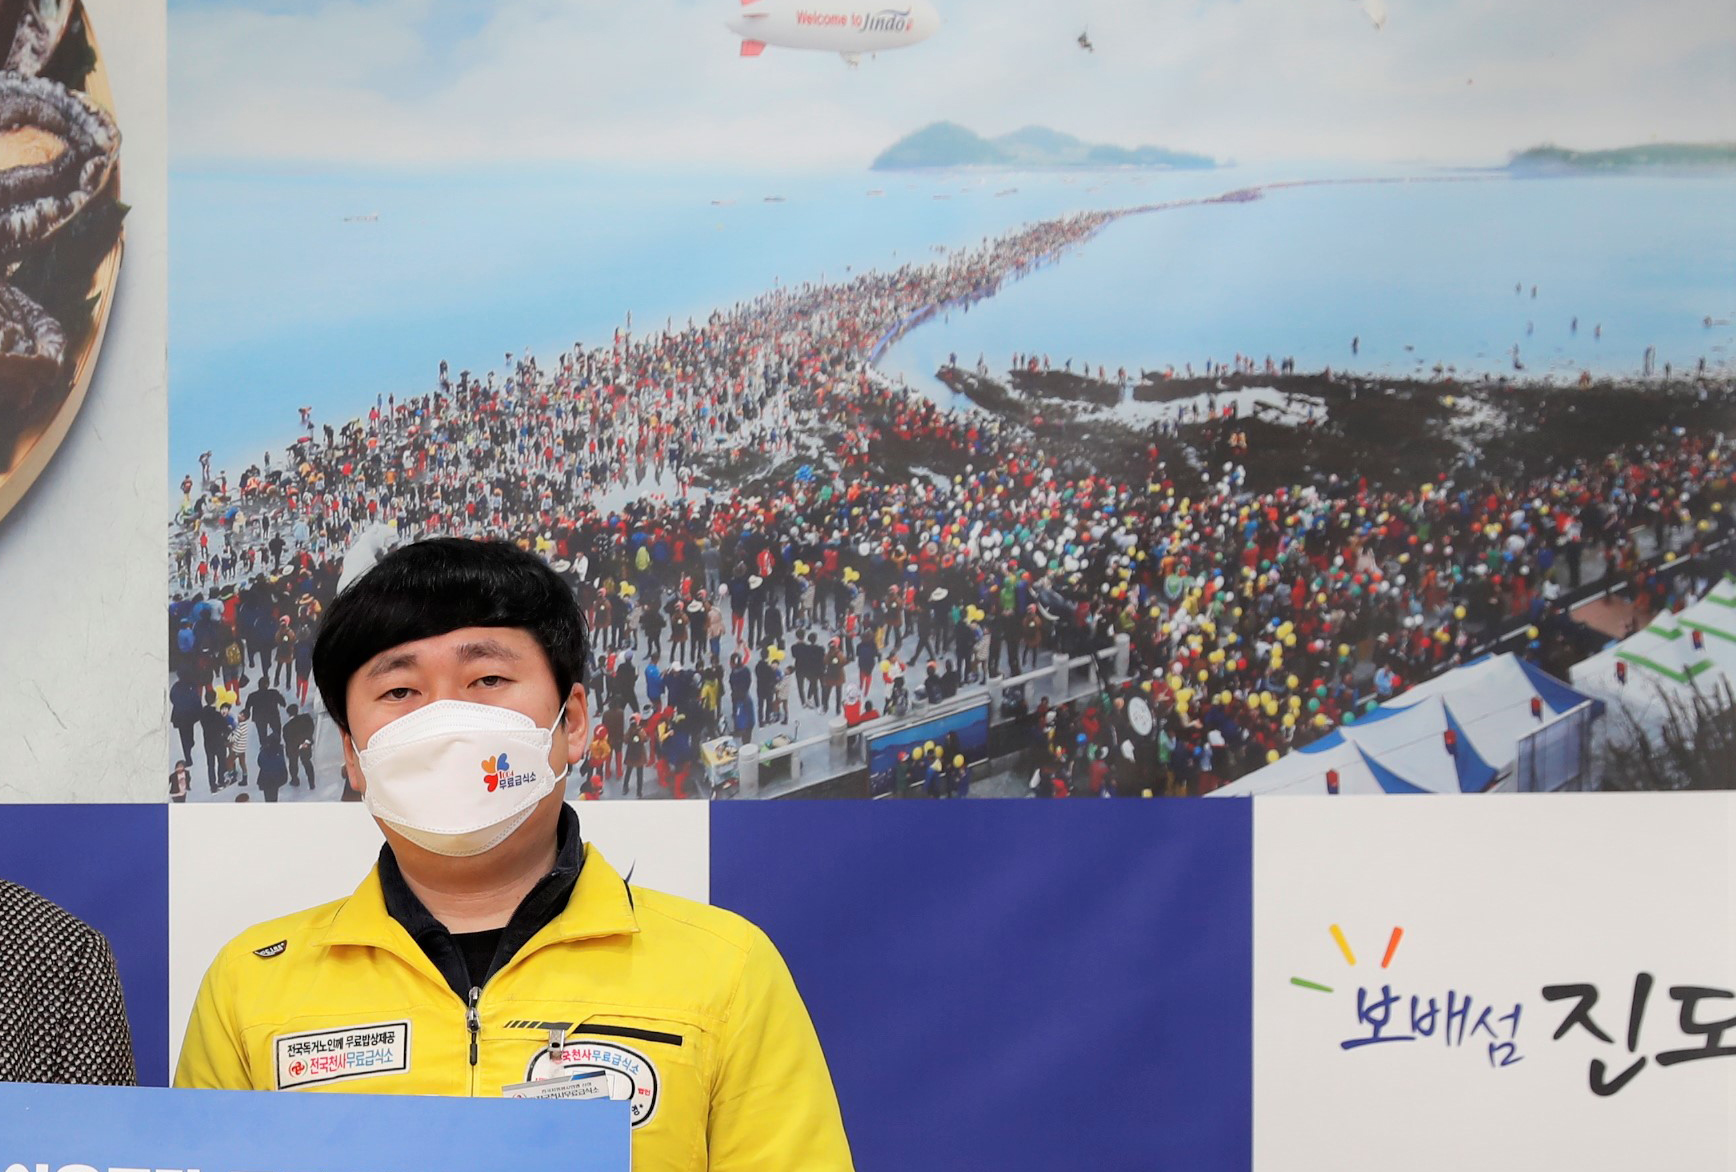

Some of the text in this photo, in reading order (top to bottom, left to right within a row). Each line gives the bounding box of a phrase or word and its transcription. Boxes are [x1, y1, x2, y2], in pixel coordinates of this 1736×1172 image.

[796, 9, 905, 33] Welcome to Jindo
[499, 771, 537, 790] 무료급식소
[345, 1031, 396, 1049] 무료밥상제공
[1340, 972, 1736, 1096] 보배섬 진도
[309, 1048, 394, 1075] 전국천사무료급식소
[552, 1048, 641, 1076] 국천사무료급식소
